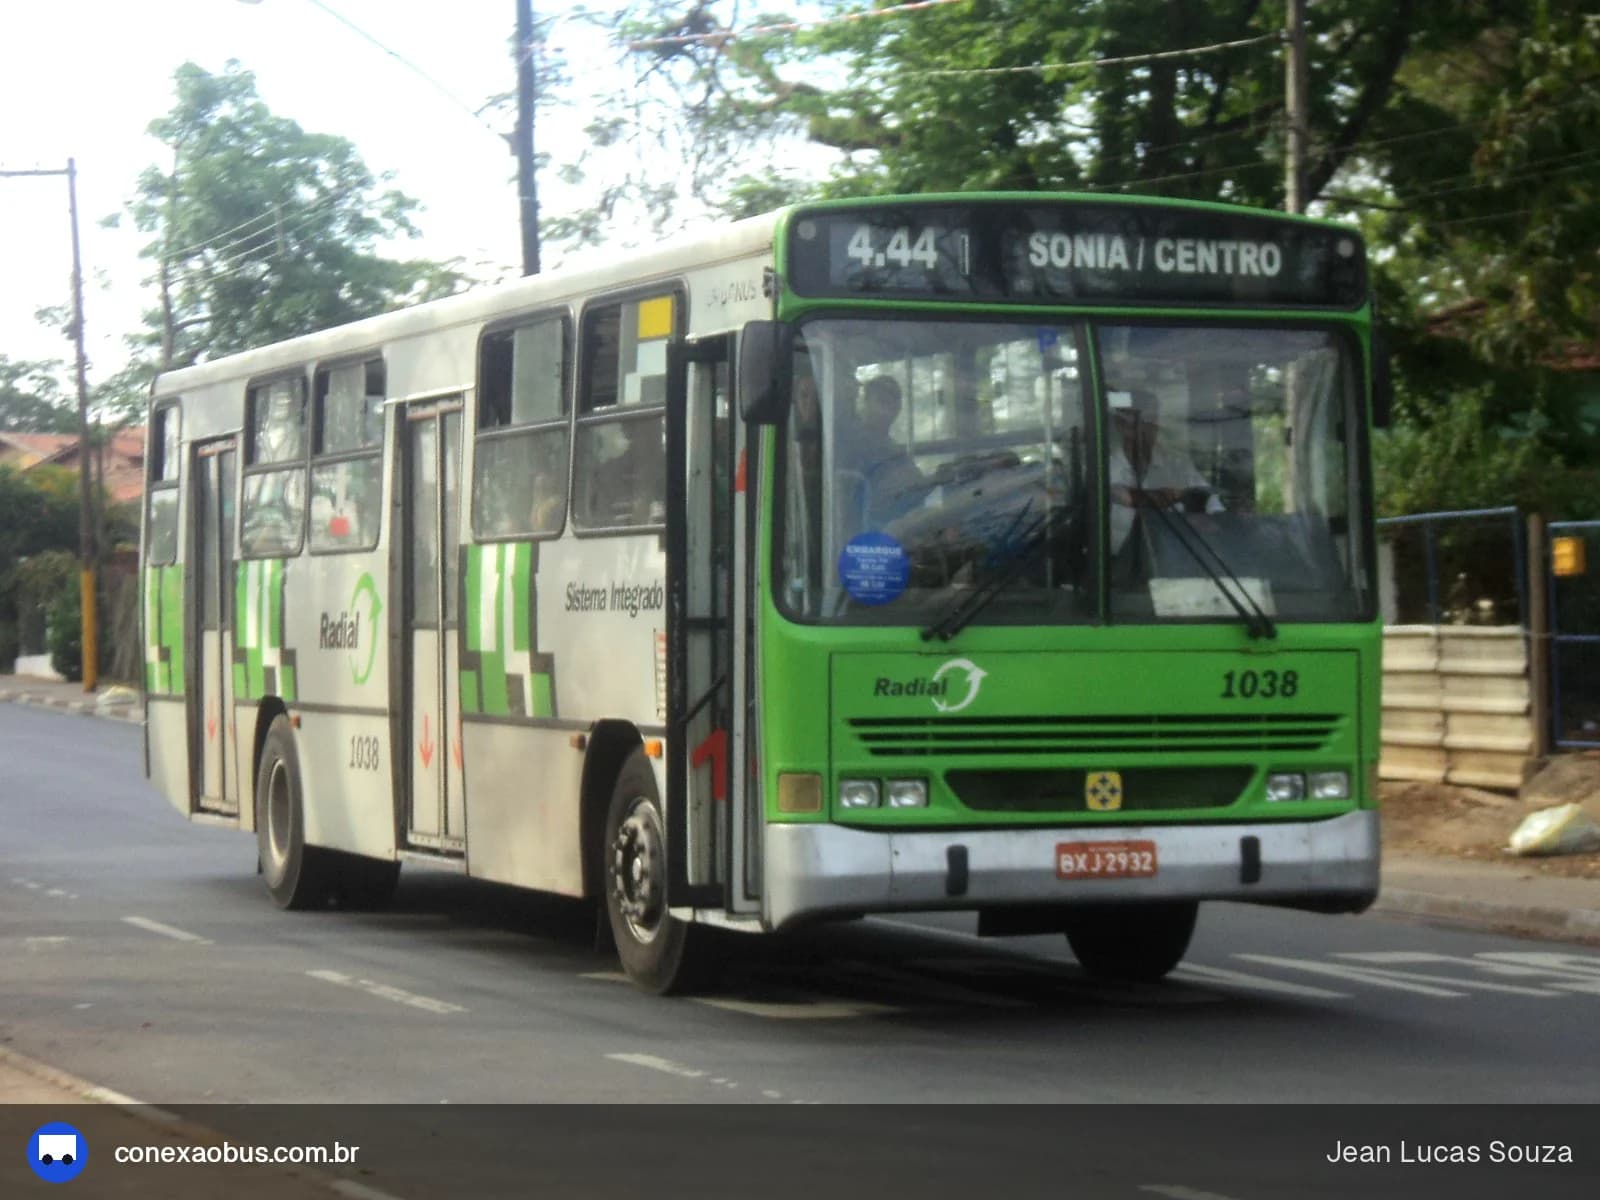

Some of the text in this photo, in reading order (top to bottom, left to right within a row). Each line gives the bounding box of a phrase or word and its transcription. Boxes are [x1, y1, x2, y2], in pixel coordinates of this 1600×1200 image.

[847, 223, 938, 269] 4.44
[1029, 232, 1282, 276] SONIA / CENTRO
[565, 578, 663, 618] Sistema Integrado
[319, 611, 360, 649] Radial
[873, 677, 948, 697] Radial
[1219, 669, 1299, 698] 1038
[349, 735, 379, 771] 1038
